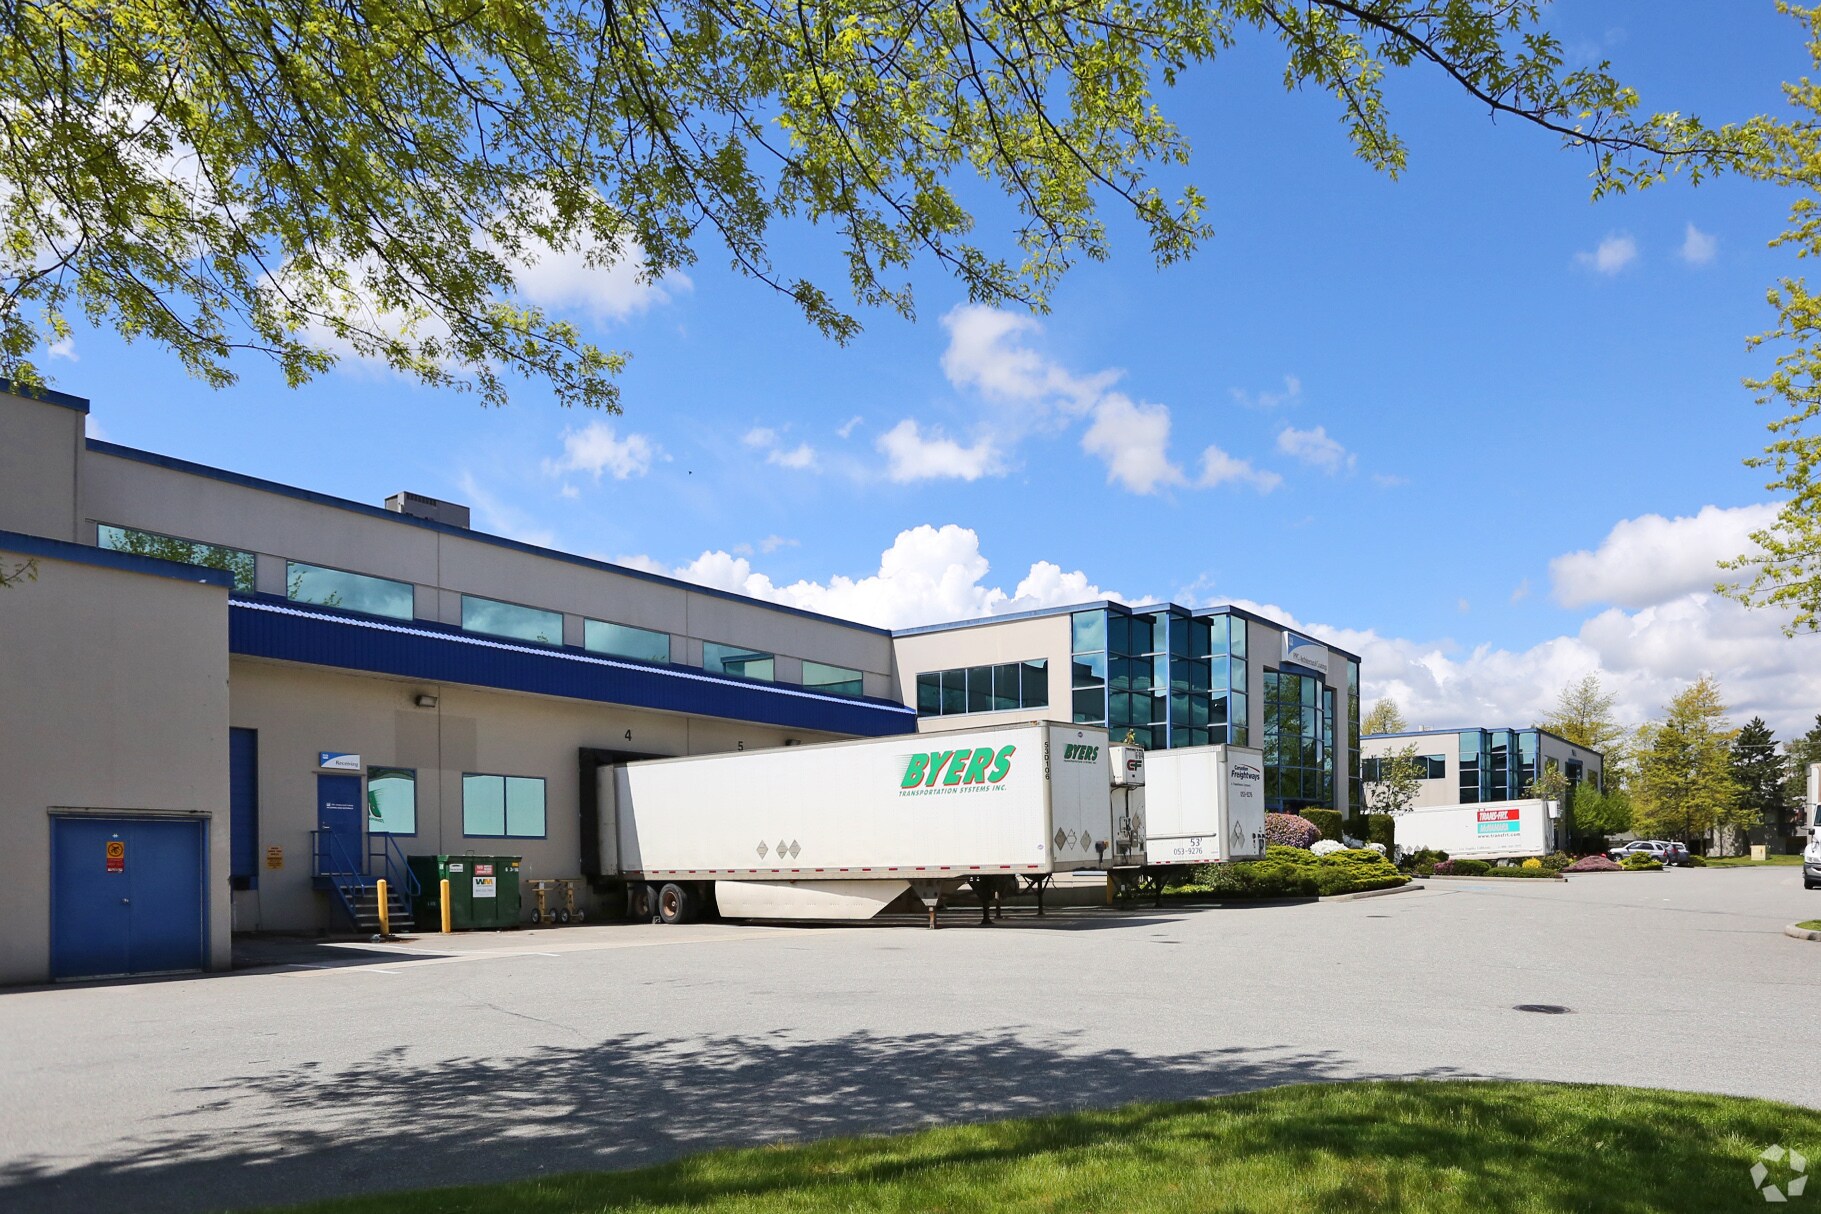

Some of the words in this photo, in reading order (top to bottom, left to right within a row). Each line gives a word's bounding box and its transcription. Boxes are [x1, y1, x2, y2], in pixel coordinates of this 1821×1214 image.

[624, 729, 632, 742] 4
[737, 741, 744, 751] 5
[1063, 743, 1099, 761] BYERS
[899, 744, 1017, 789] BYERS
[1231, 769, 1260, 781] Freightways
[899, 788, 958, 797] TRANSPORTATION
[960, 785, 990, 794] SYSTEMS
[1173, 847, 1203, 855] 053-9276
